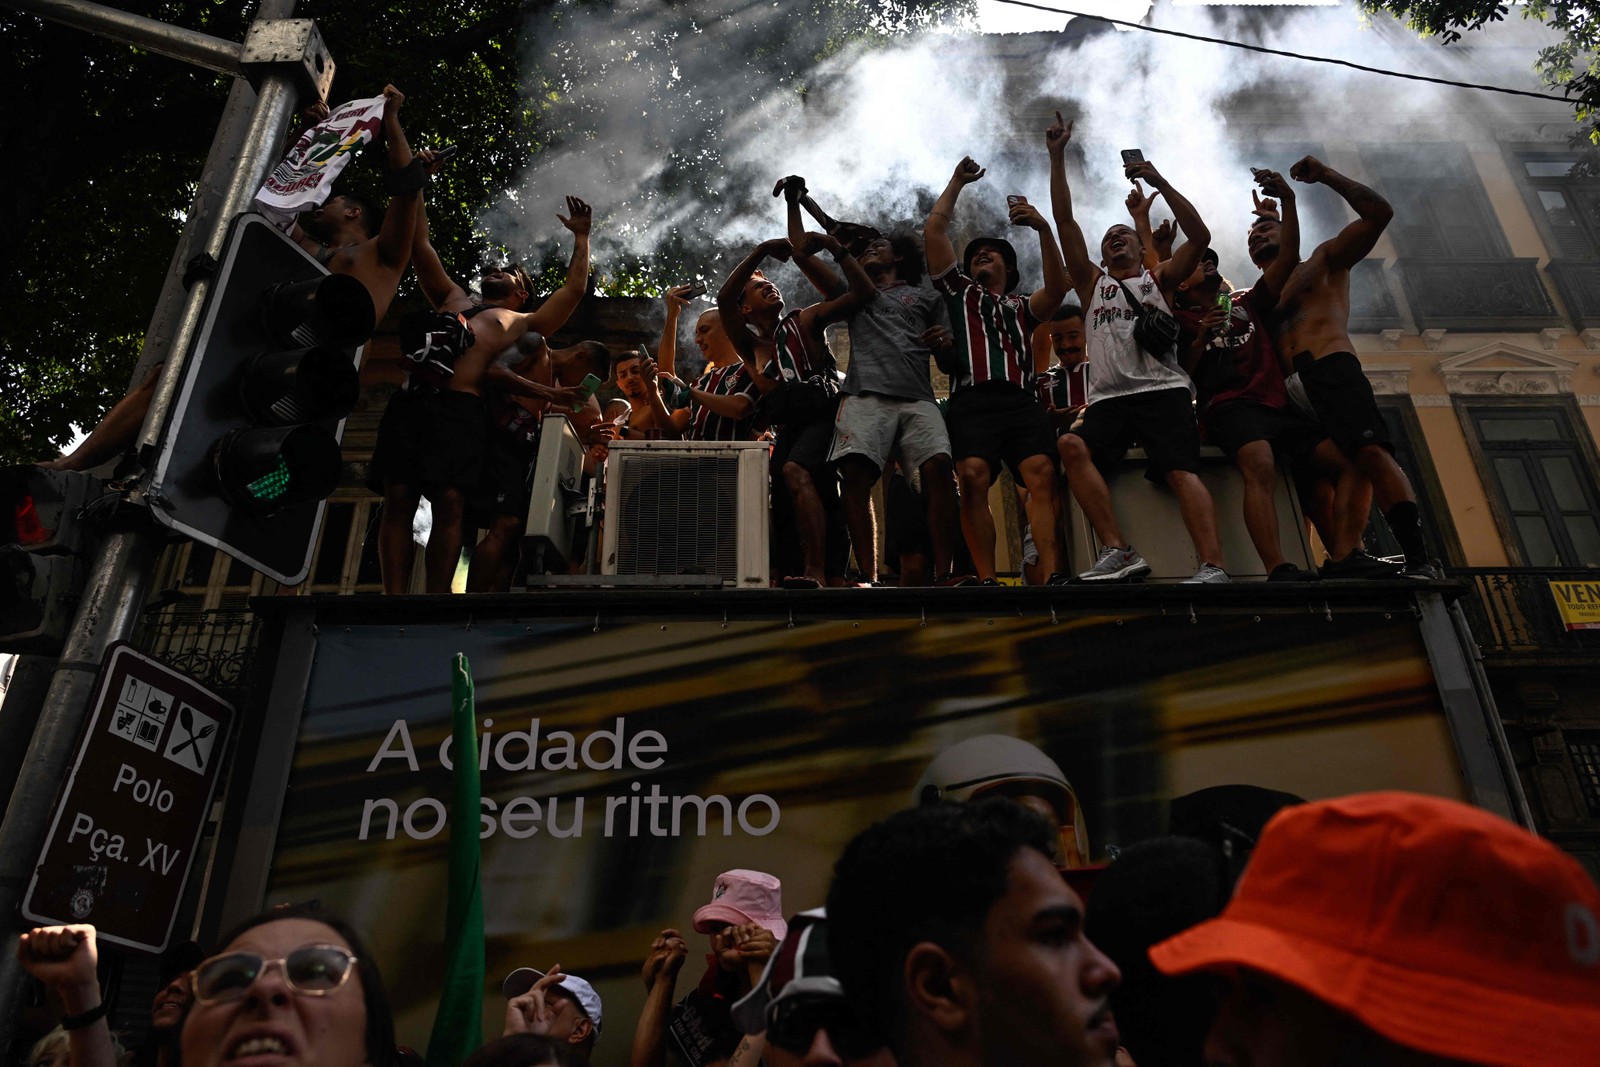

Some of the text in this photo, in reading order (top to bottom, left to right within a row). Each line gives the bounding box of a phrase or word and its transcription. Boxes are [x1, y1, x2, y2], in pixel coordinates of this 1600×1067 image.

[366, 719, 421, 773] A
[112, 763, 174, 814] Polo
[358, 797, 447, 841] no
[603, 782, 781, 838] ritmo
[67, 812, 130, 863] Pça.
[138, 838, 181, 877] XV
